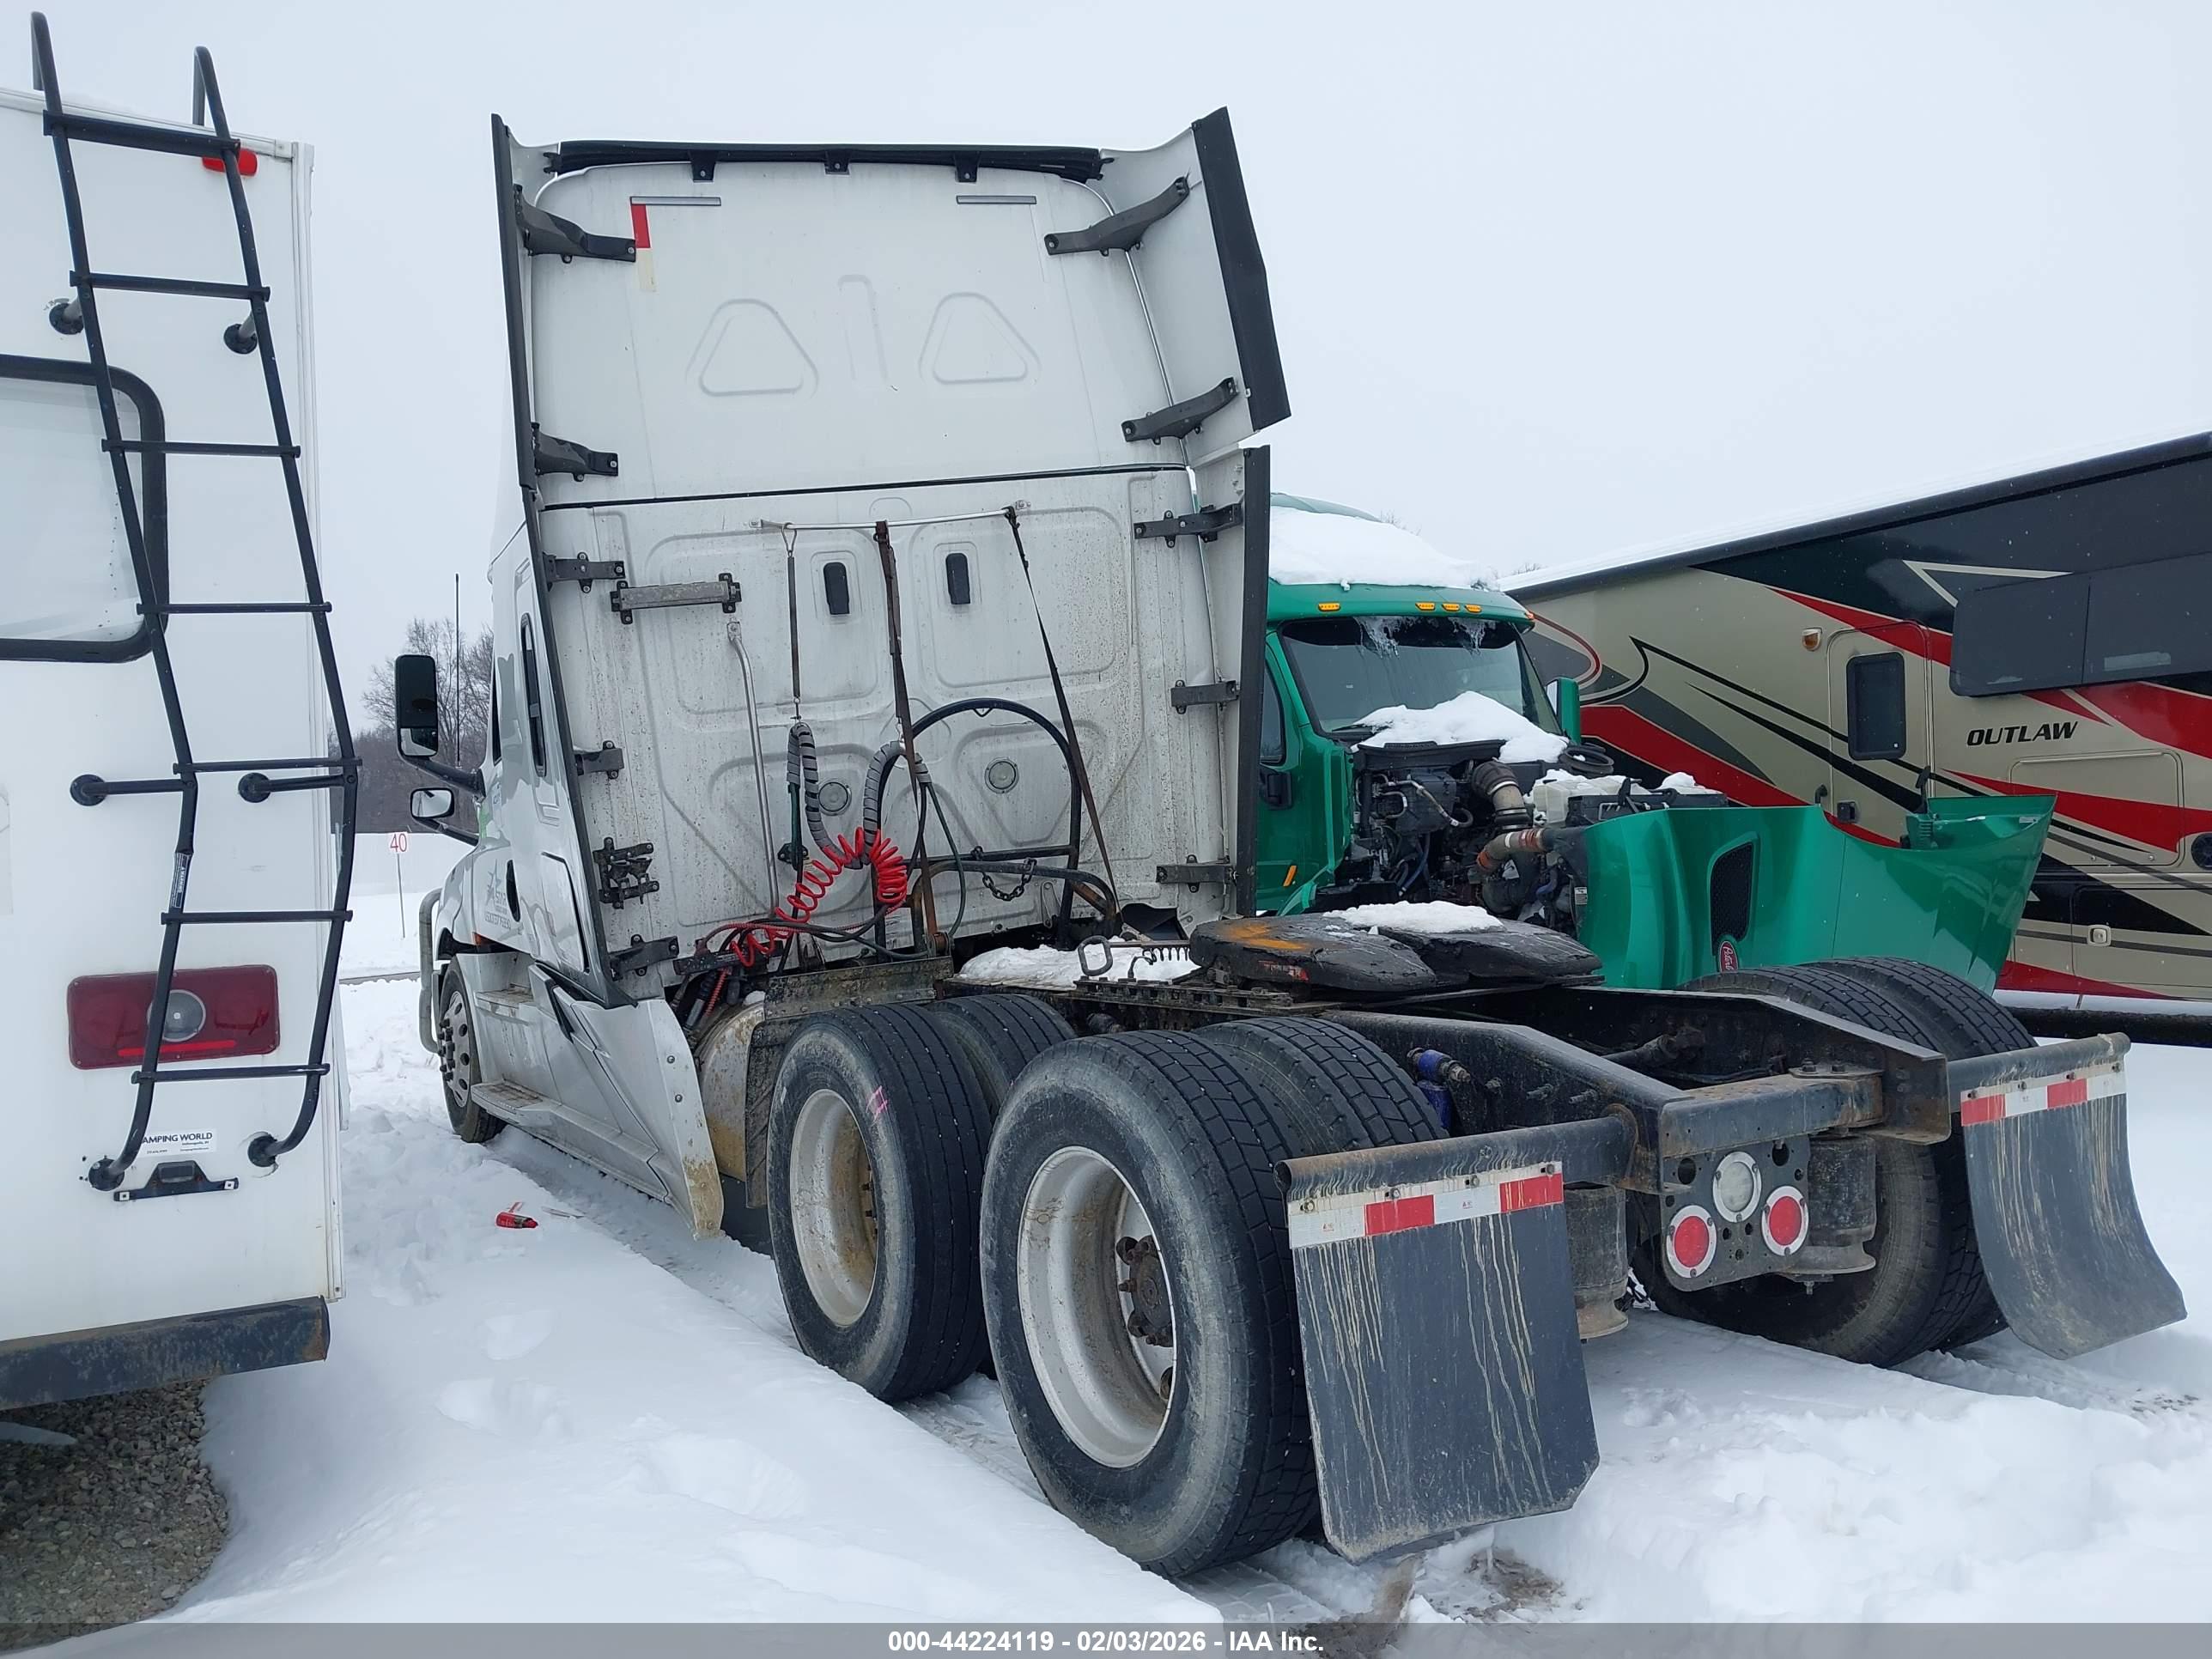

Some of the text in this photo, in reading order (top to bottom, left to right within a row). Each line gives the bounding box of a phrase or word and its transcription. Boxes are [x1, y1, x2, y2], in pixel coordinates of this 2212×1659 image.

[1966, 721, 2078, 746] OUTLAW
[390, 833, 407, 852] 40
[1723, 946, 1734, 970] Peterb
[143, 1135, 179, 1144] AMPING
[179, 1133, 213, 1141] WORLD
